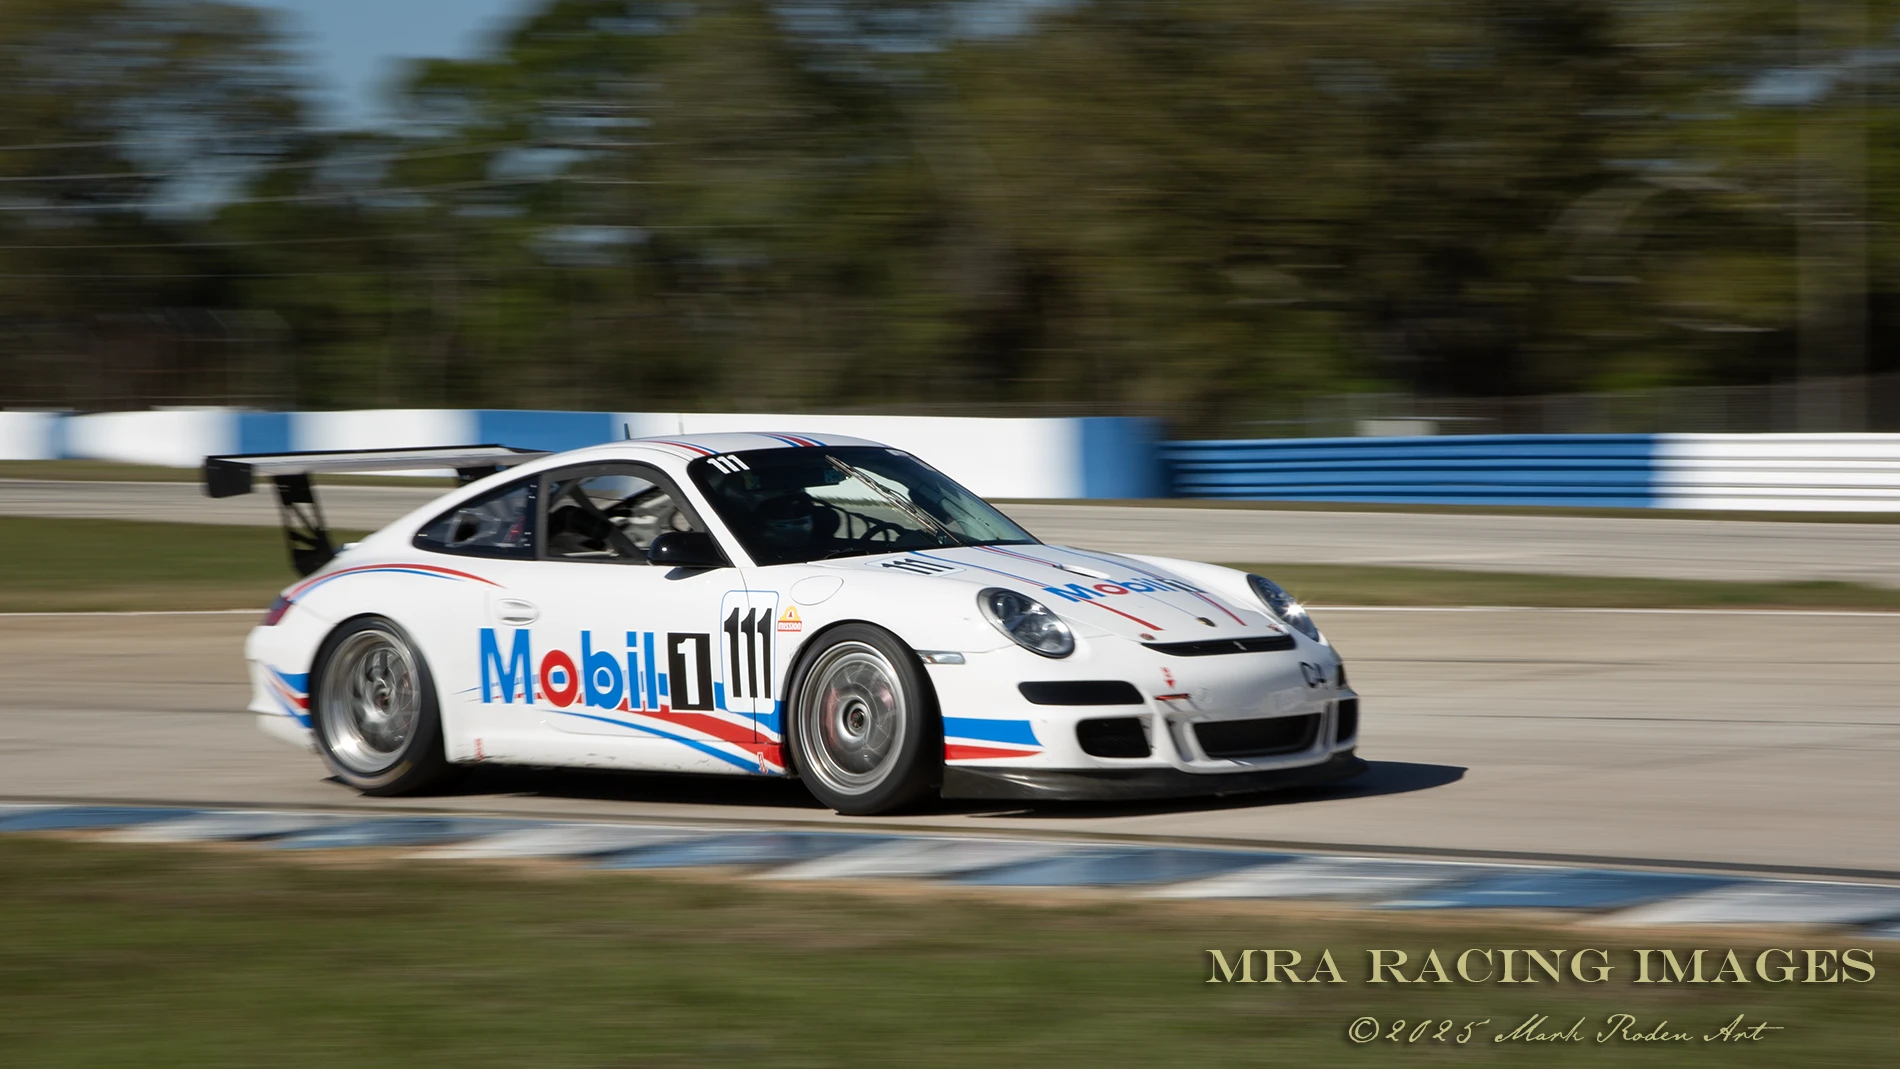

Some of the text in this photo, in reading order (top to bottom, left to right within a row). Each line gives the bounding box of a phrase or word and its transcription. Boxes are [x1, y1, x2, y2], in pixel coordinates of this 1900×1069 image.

[706, 454, 750, 474] 111
[881, 558, 955, 575] 111
[1042, 577, 1178, 602] Mobil
[724, 607, 772, 699] 111
[480, 628, 701, 709] Mobil 1
